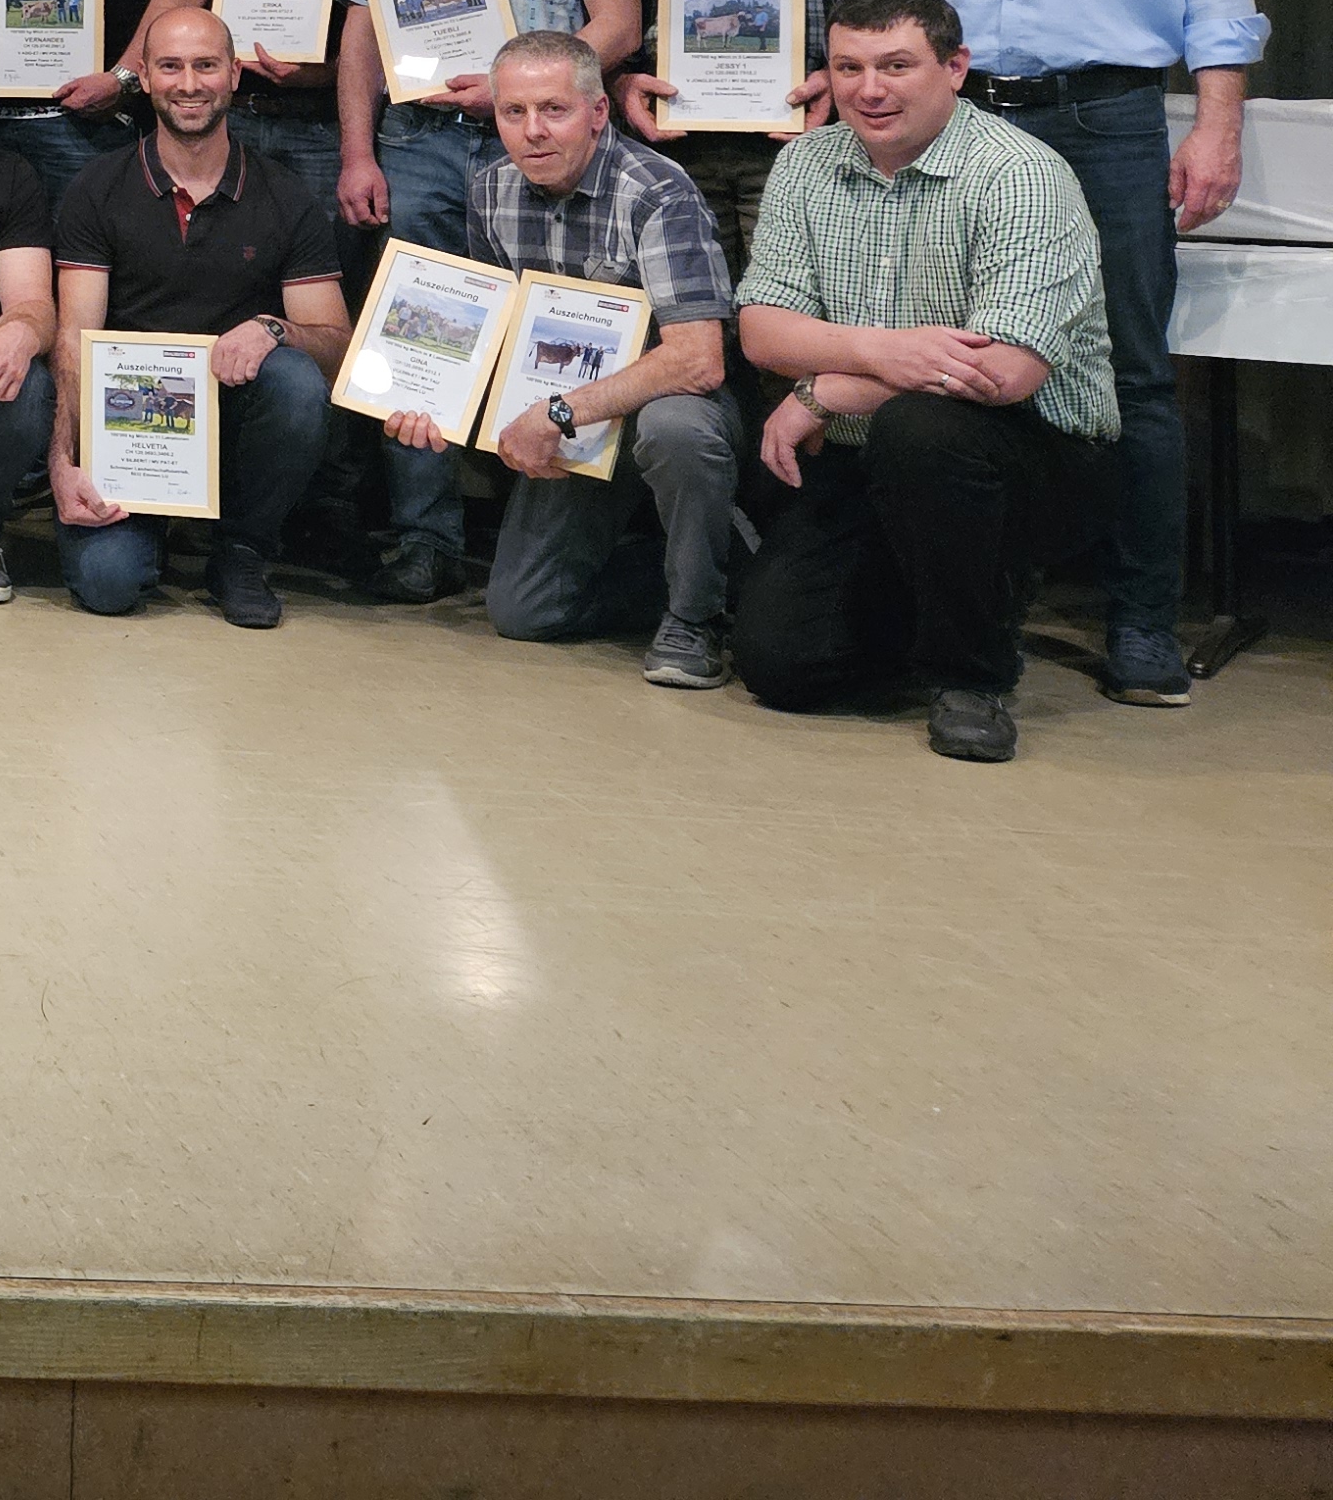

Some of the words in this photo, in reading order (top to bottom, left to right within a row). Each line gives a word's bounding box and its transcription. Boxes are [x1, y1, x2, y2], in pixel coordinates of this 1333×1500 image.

[413, 277, 479, 302] Auszeichnung
[549, 307, 613, 326] Auszeichnung
[410, 356, 428, 366] GINA
[117, 362, 183, 374] Auszeichnung
[132, 442, 168, 450] HELVETIA
